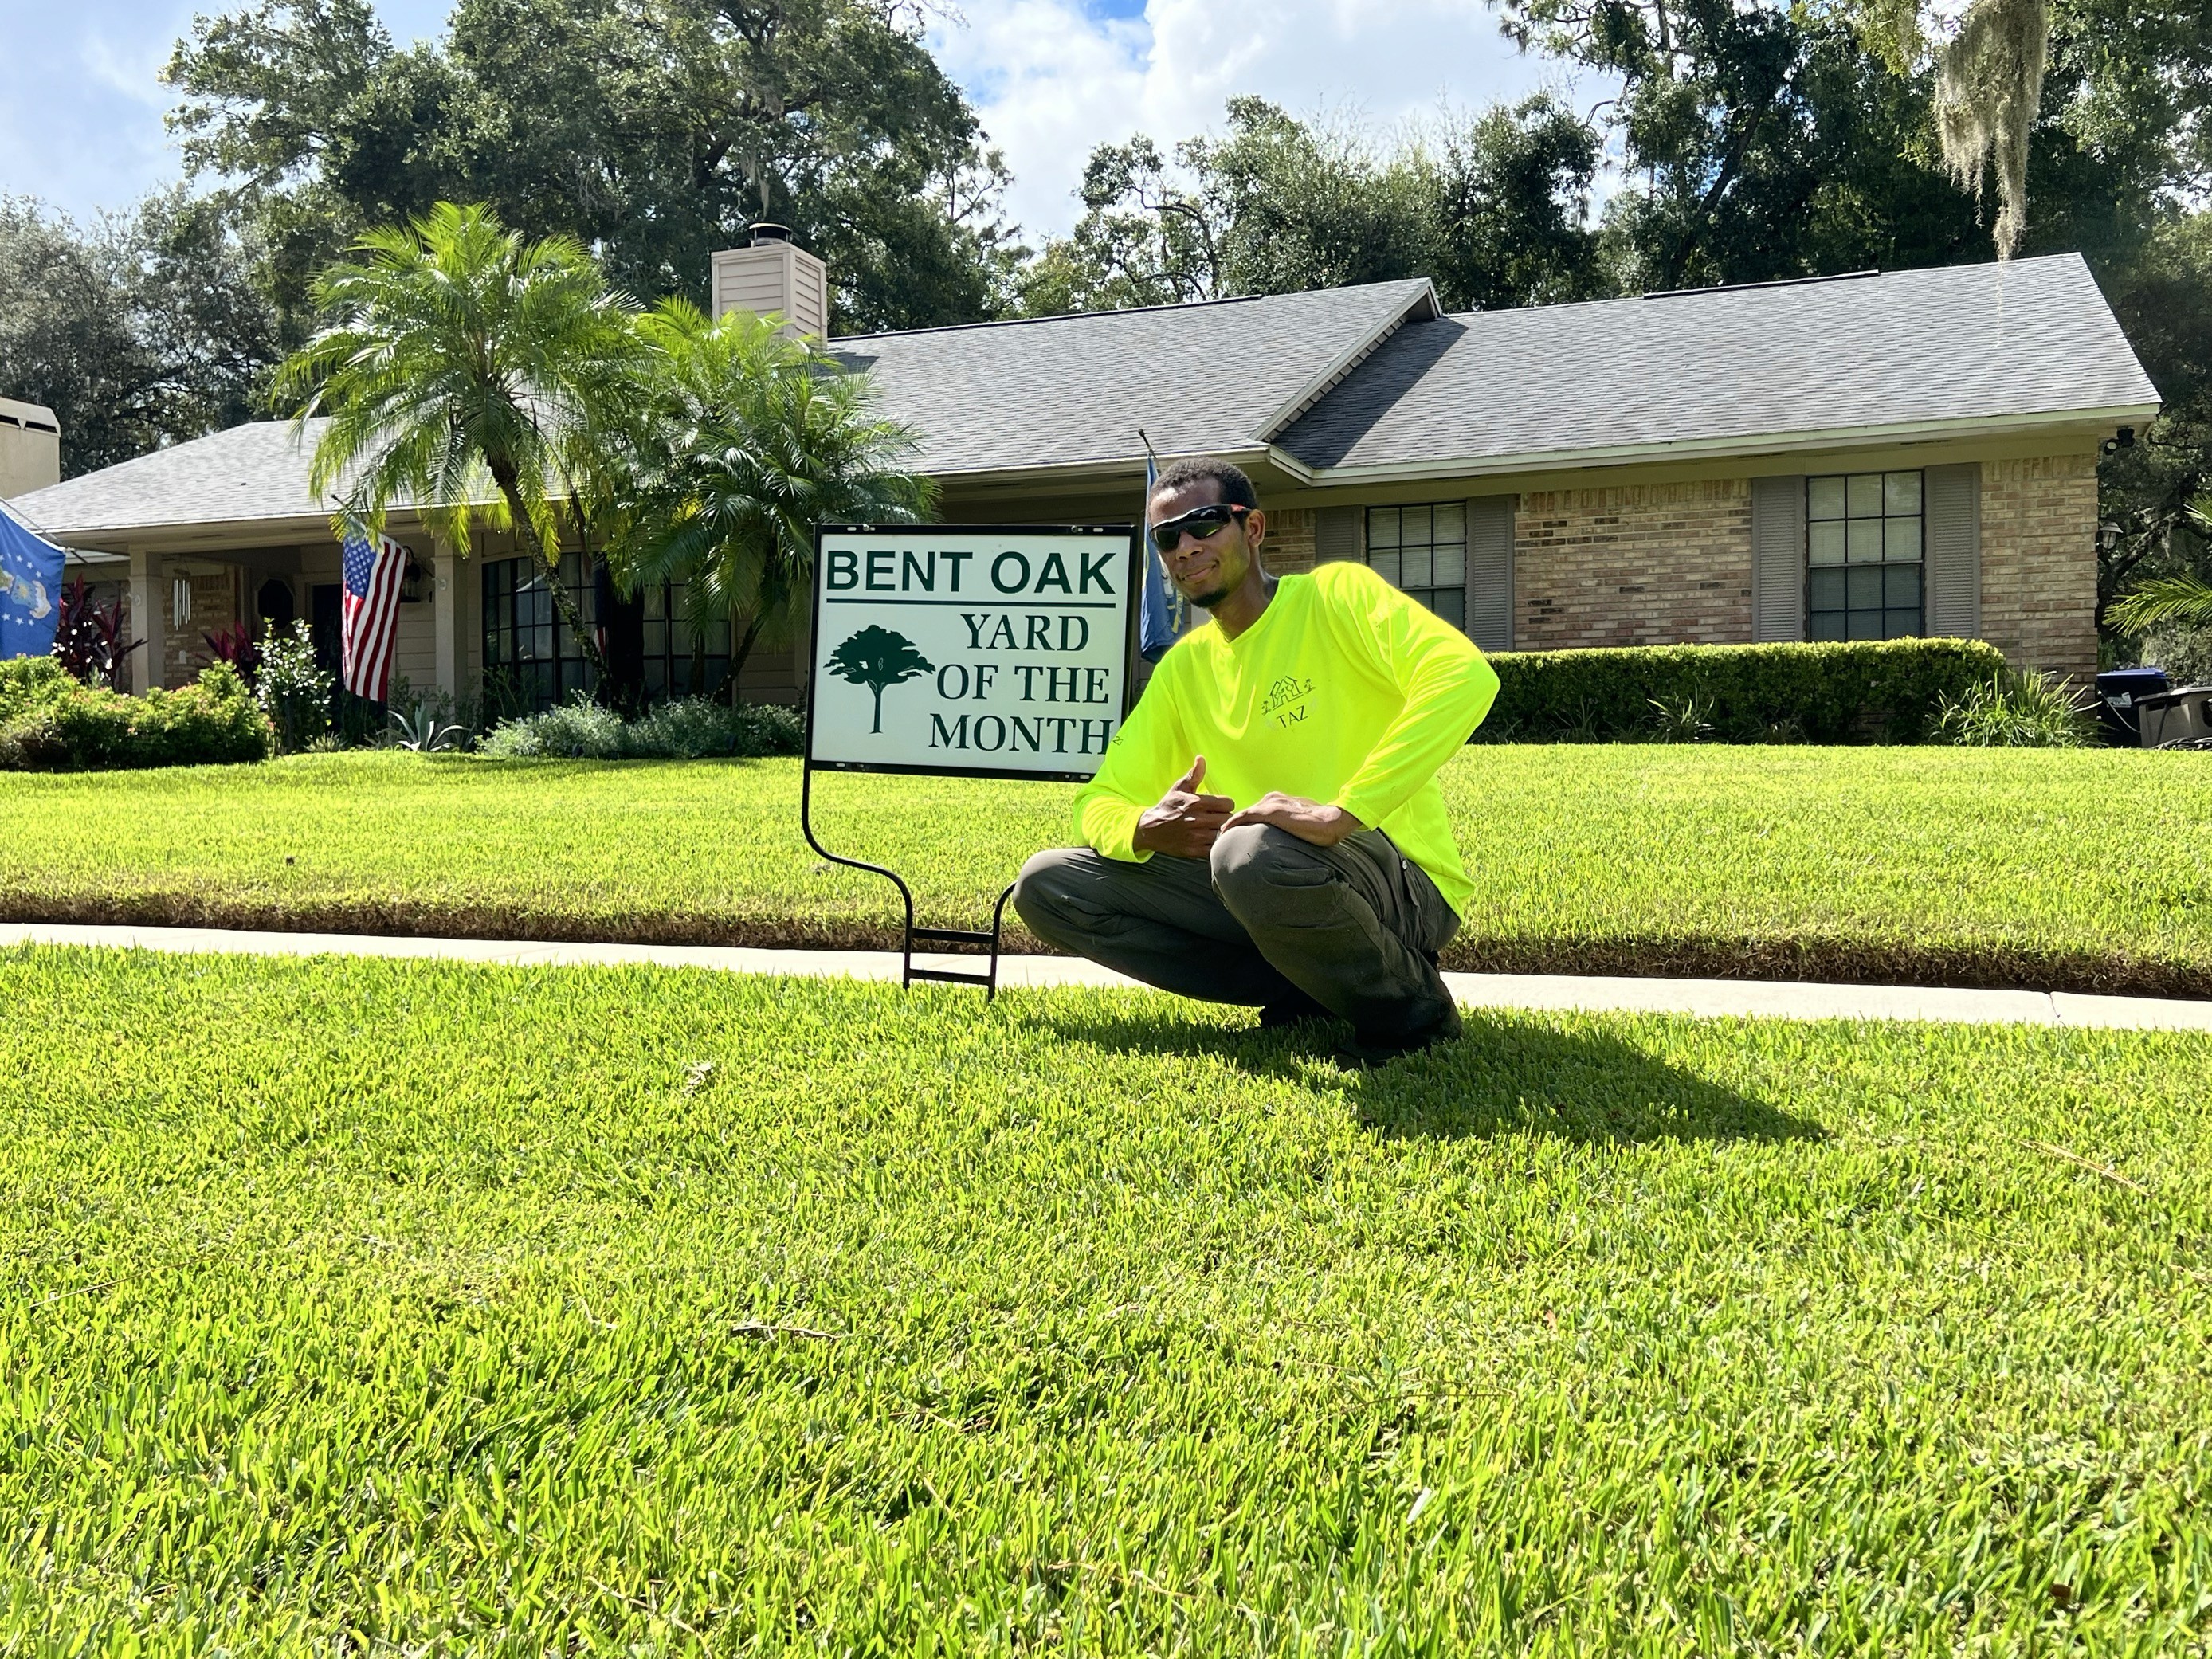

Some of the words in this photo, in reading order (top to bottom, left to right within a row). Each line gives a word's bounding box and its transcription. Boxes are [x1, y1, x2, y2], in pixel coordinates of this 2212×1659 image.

[826, 550, 974, 593] BENT
[990, 551, 1117, 595] OAK
[959, 614, 1089, 652] YARD
[936, 664, 999, 700] OF
[1014, 665, 1110, 704] THE
[928, 712, 1115, 755] MONTH
[1276, 705, 1308, 728] TAZ
